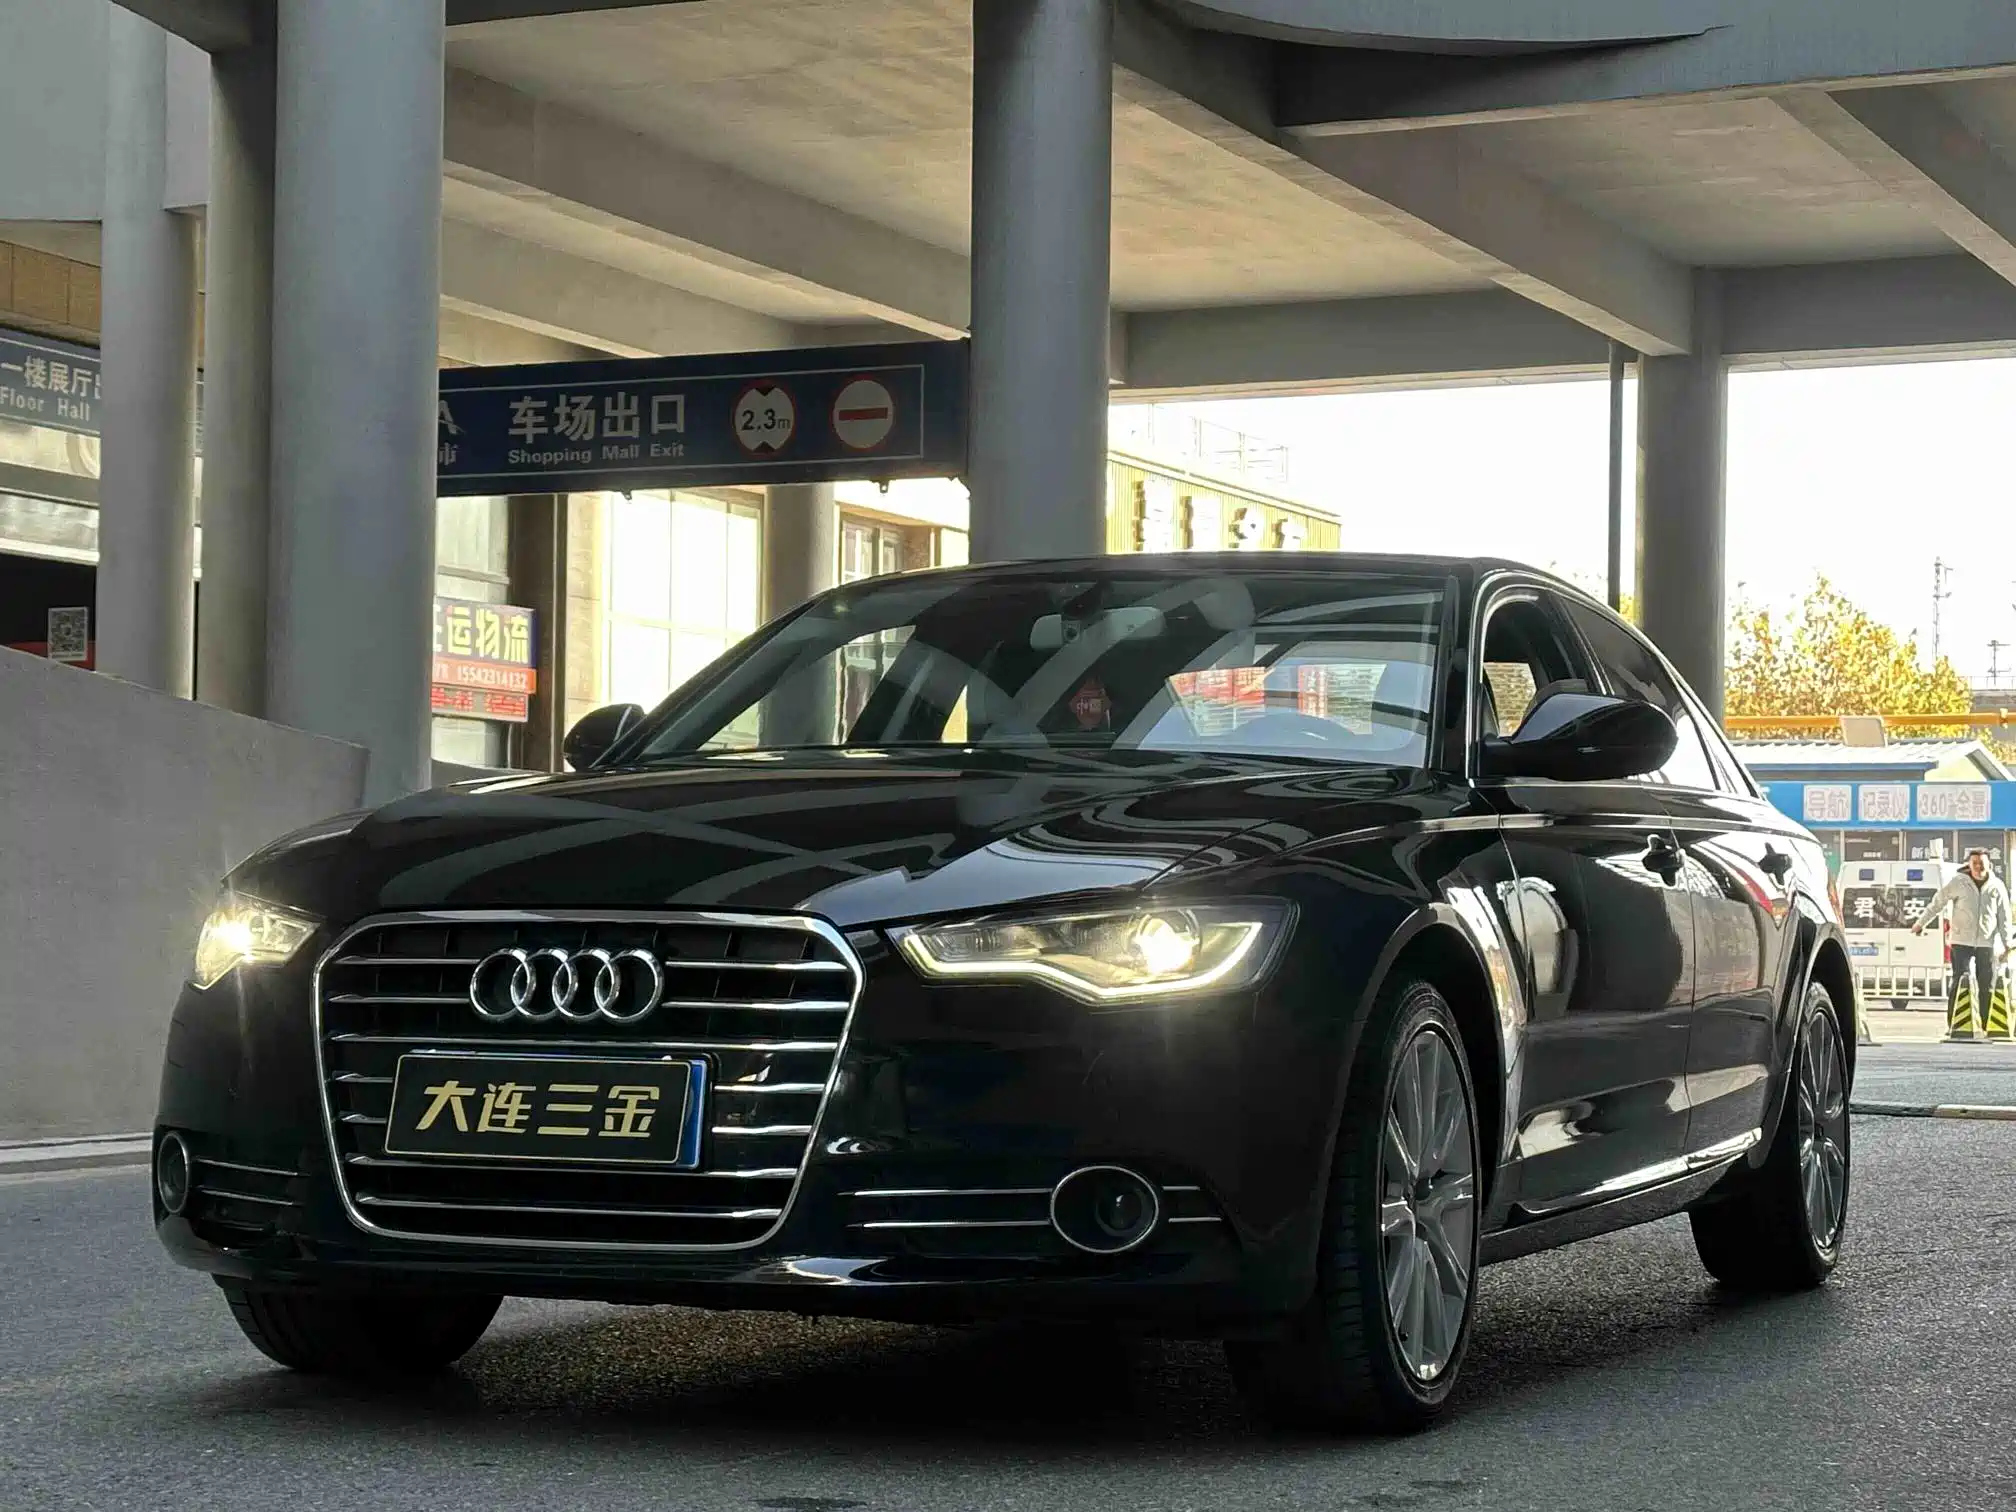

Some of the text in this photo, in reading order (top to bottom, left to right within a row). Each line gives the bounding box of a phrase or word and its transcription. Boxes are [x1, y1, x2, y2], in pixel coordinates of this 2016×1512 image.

[0, 386, 91, 422] Floor Hall
[508, 392, 686, 444] 车场出口
[741, 407, 791, 431] 2.3m
[508, 442, 685, 465] Shopping Mall Exit
[415, 1080, 660, 1138] 大连三金
